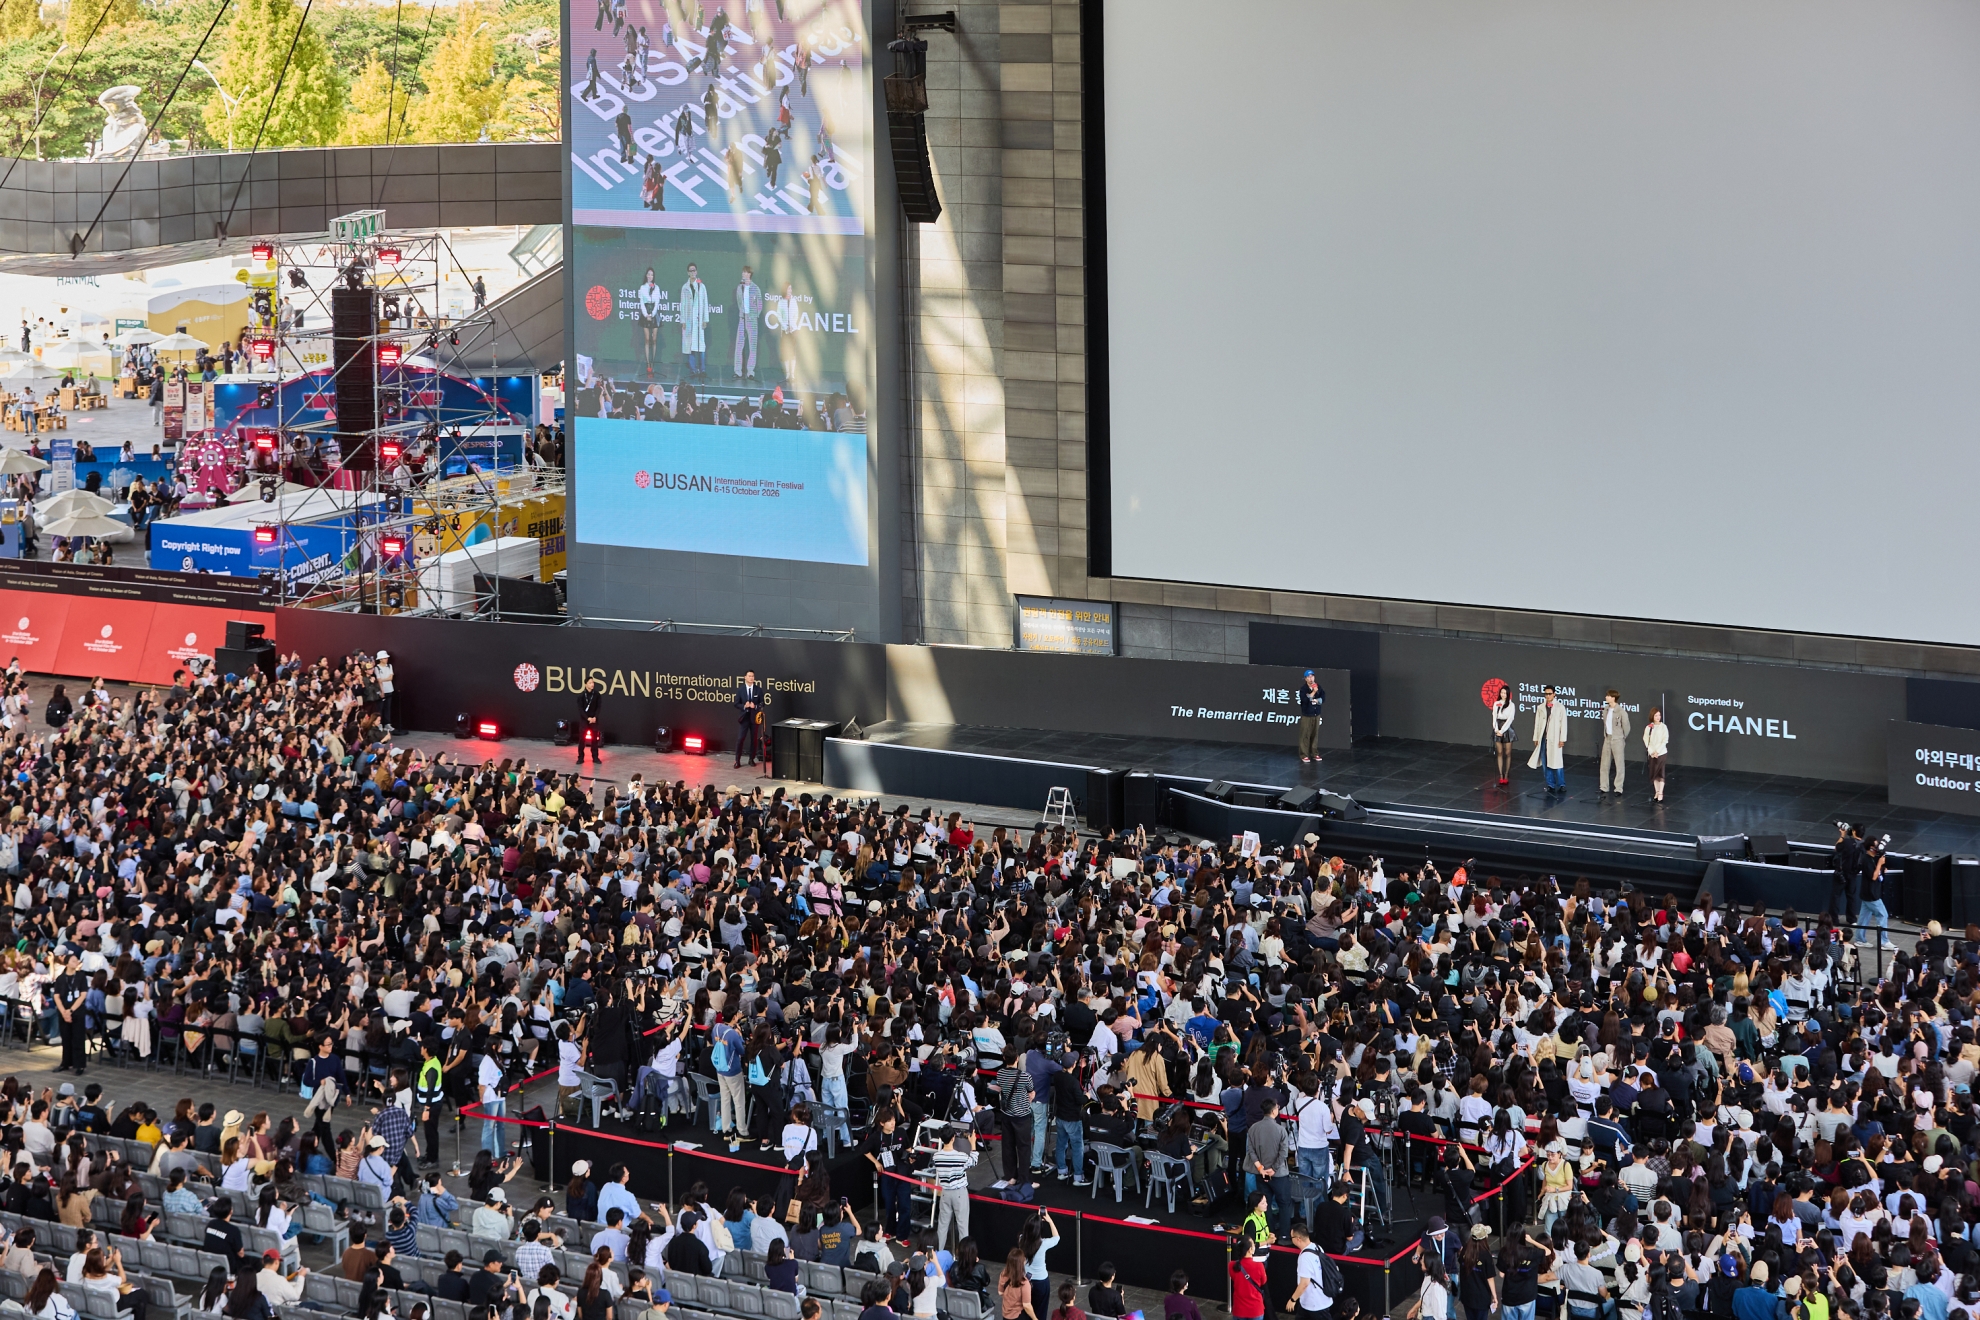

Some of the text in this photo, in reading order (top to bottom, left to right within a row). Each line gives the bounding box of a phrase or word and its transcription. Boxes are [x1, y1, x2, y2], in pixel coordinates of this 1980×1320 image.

[804, 294, 813, 304] by
[764, 310, 859, 333] CANEL
[654, 472, 712, 492] BUSAN
[714, 476, 758, 486] International
[760, 480, 775, 488] Film
[776, 481, 804, 490] Festival
[732, 487, 760, 496] October
[528, 516, 560, 539] 문화비
[162, 540, 241, 556] Copyright Right now
[1075, 610, 1091, 622] 위한
[1093, 612, 1110, 624] 안내
[546, 666, 815, 698] BUSAN International Fm Festival
[1519, 682, 1576, 696] 31st BSAN
[655, 687, 736, 703] 6-15 October
[1262, 688, 1290, 704] 재혼
[1580, 698, 1600, 708] Film
[1688, 695, 1744, 710] Supported by
[1170, 706, 1323, 726] The Remarried Emprs
[1519, 704, 1536, 713] 6-1
[1584, 709, 1604, 720] 202
[1688, 712, 1796, 739] CHANEL
[1916, 773, 1971, 791] Outdoor
